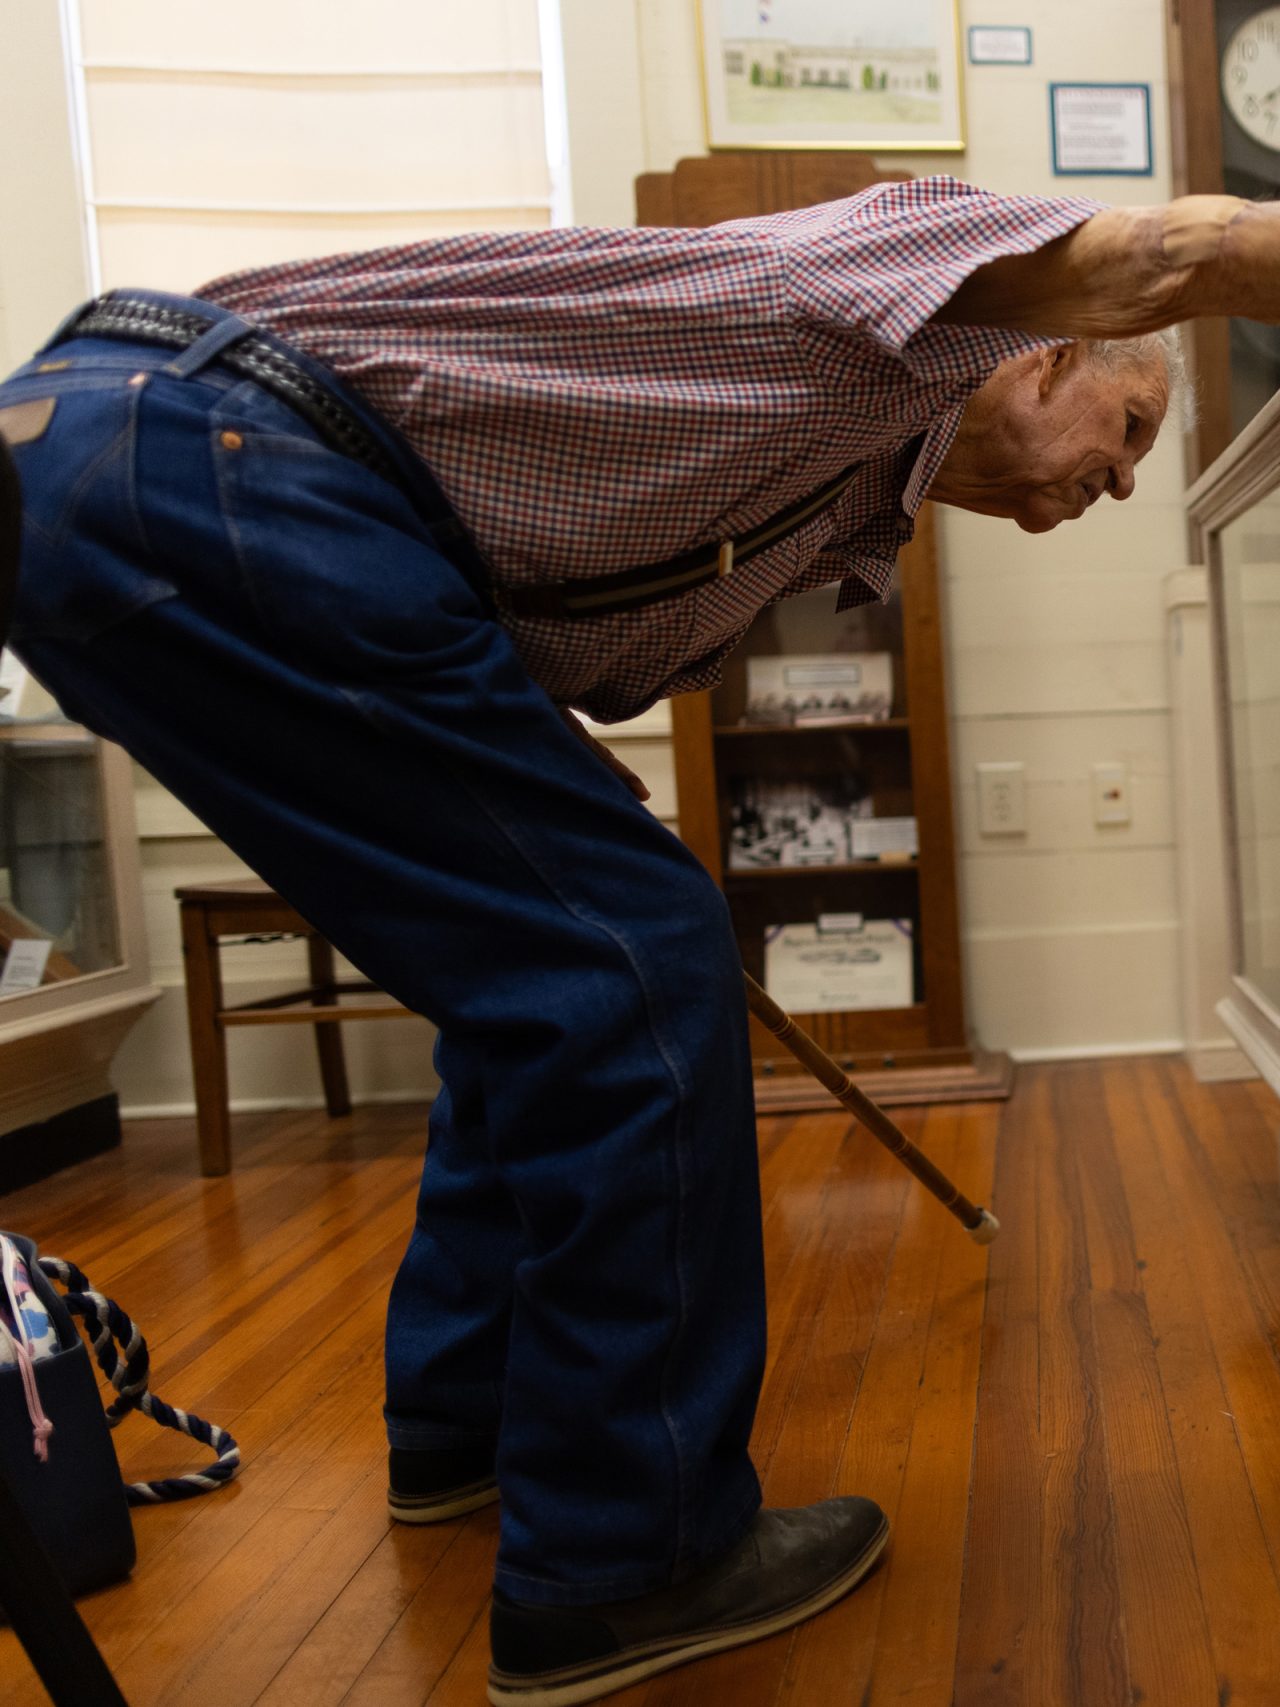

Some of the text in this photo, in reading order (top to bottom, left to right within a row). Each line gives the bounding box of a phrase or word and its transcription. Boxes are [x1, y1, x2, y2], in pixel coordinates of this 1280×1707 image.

[1237, 38, 1259, 62] 10
[1231, 65, 1248, 88] 9
[1242, 93, 1259, 118] 8
[1264, 111, 1278, 135] 7
